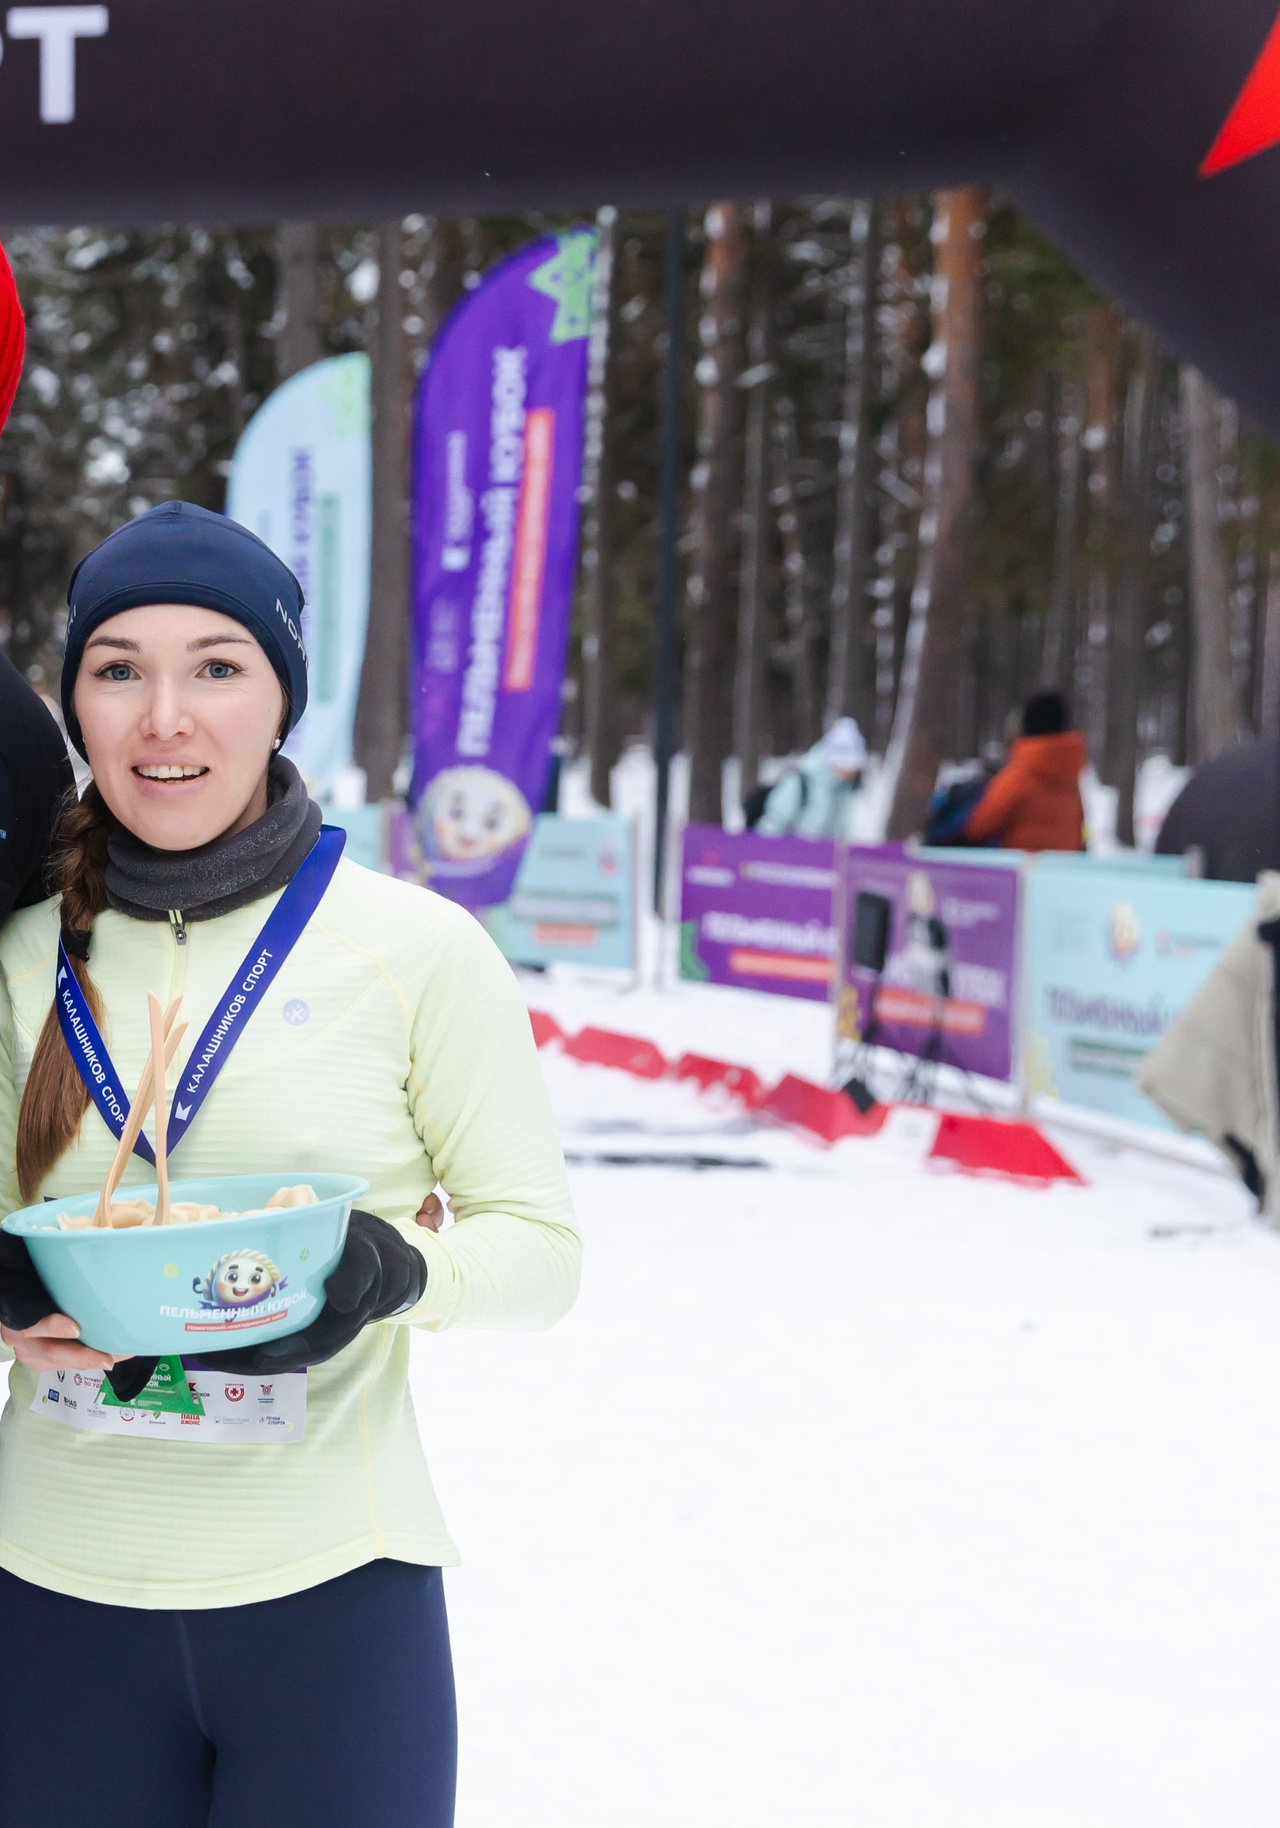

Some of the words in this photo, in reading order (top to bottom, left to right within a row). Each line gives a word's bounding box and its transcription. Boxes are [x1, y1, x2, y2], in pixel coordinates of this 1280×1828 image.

[489, 346, 527, 483] КУБОК
[62, 988, 107, 1084] КАЛАШНИКОВ
[186, 993, 247, 1094] КАЛАШНИКОВ
[242, 948, 274, 992] СПОРТ
[159, 1304, 266, 1321] ПЕЛЬМЕННЫЙ
[267, 1289, 308, 1312] КУБОК
